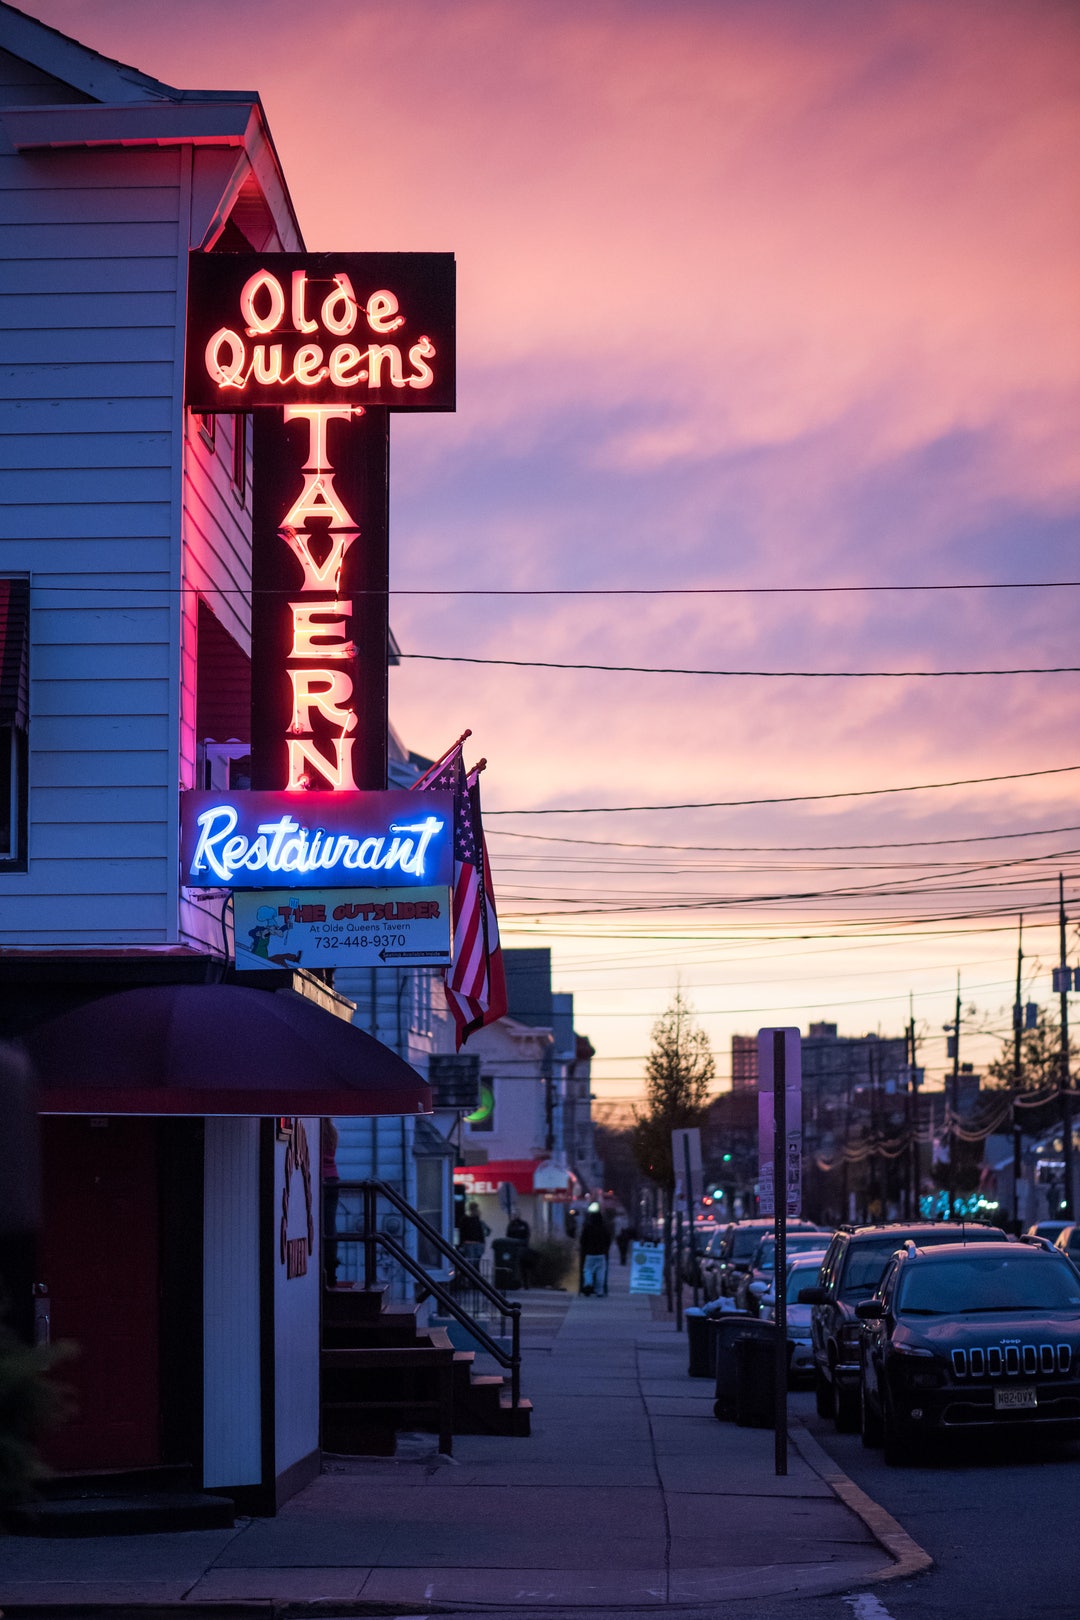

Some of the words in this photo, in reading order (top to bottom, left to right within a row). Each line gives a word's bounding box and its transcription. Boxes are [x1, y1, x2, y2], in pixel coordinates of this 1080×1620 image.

[240, 268, 404, 336] Olde
[205, 327, 437, 389] Queens
[277, 404, 363, 791] TAVERN
[189, 805, 444, 881] Restaurant
[278, 904, 327, 923] THE
[332, 901, 441, 921] OUTSLIDER
[310, 924, 320, 933] At
[322, 924, 344, 933] Olde
[346, 923, 380, 932] Queens
[383, 922, 411, 931] Tavern
[315, 934, 406, 949] 732-448-9370
